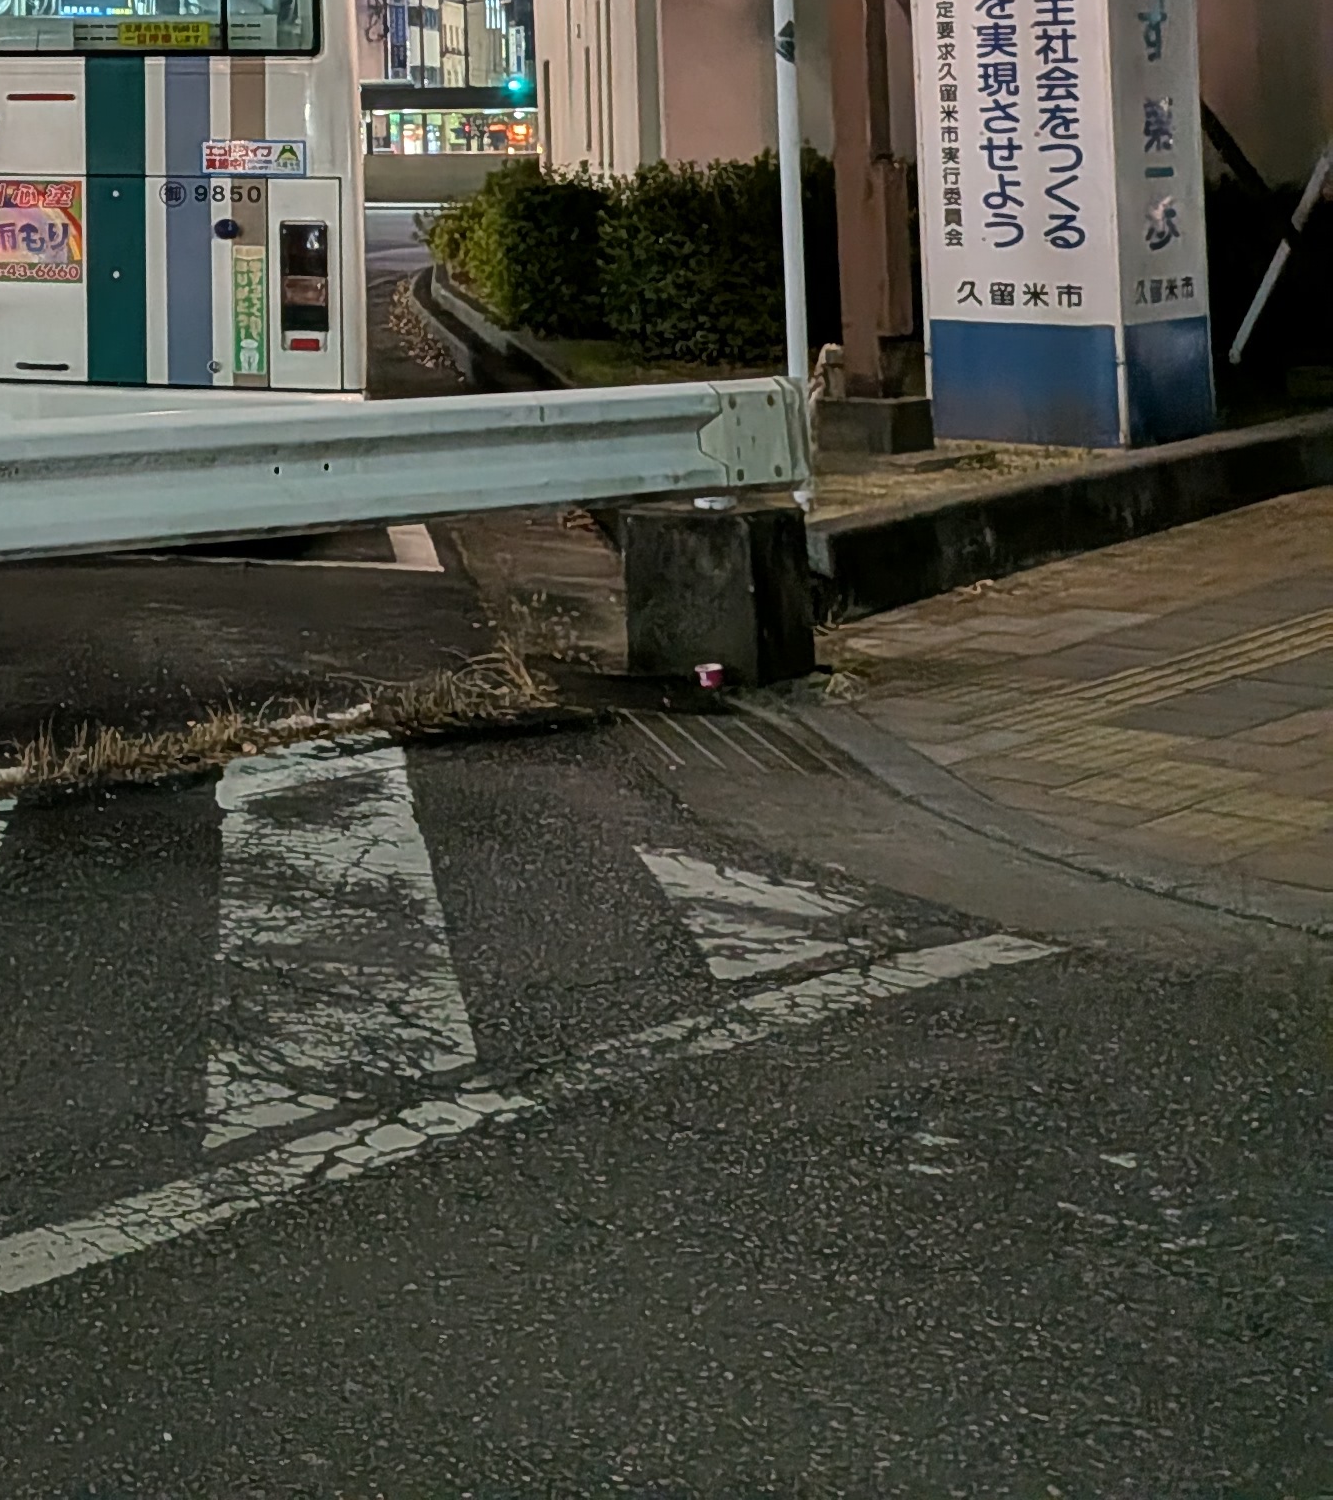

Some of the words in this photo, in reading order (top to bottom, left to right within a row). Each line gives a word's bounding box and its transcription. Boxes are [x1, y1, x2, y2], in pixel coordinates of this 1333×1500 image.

[194, 184, 262, 204] 9850
[956, 280, 1083, 308] 久留米市
